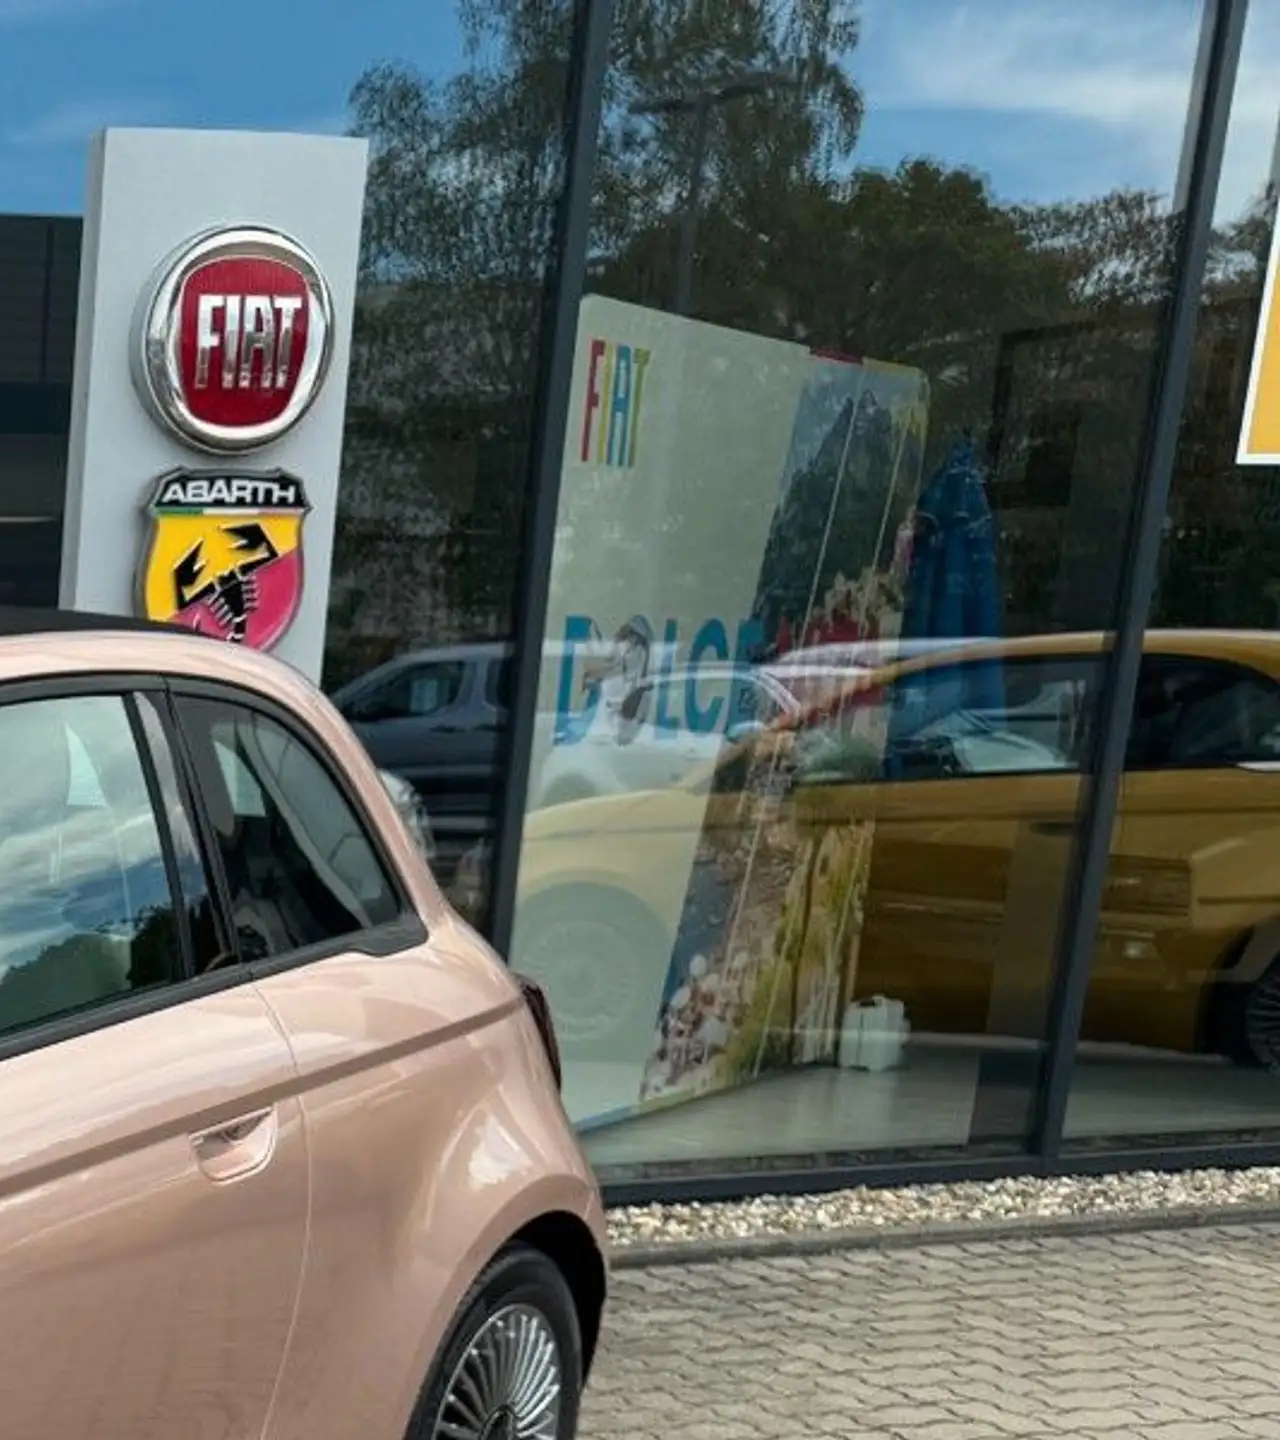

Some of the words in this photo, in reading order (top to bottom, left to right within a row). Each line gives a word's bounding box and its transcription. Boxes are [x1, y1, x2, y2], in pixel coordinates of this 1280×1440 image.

[193, 293, 303, 390] FIAT
[580, 338, 652, 468] FIAT
[161, 478, 297, 504] ABARTH
[553, 613, 768, 746] DLCE
